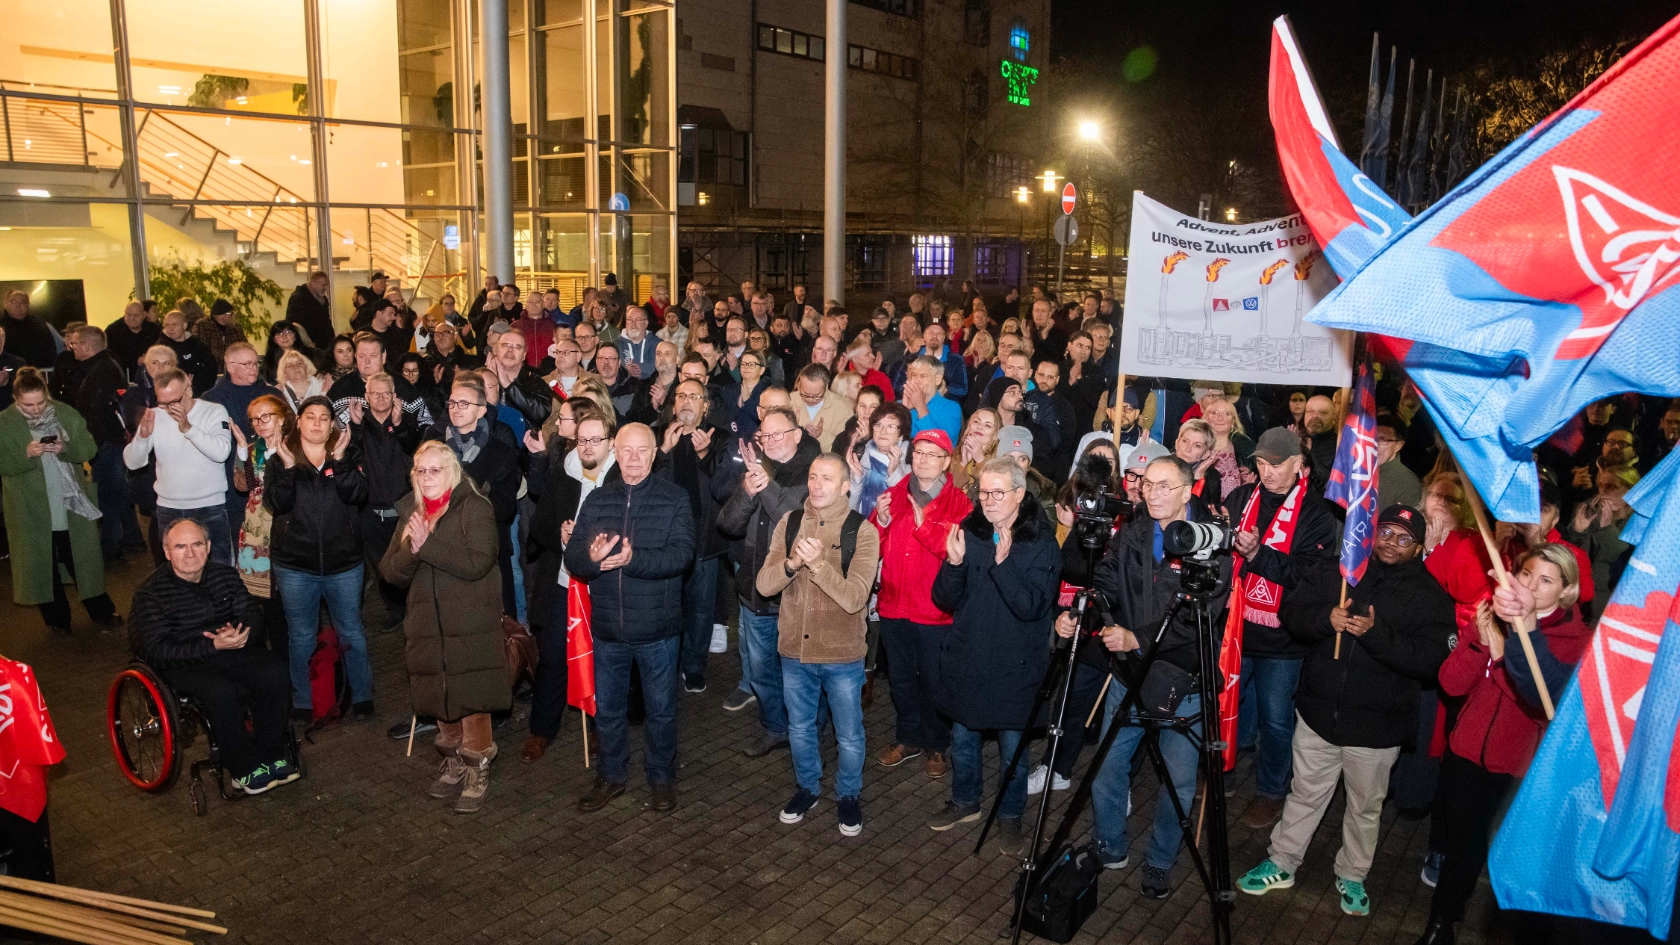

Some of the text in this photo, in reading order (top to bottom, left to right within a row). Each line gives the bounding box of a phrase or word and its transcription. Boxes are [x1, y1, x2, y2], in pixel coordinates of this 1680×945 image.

[1176, 219, 1240, 236] Advent,
[1152, 231, 1315, 255] unsere Zukunft bren
